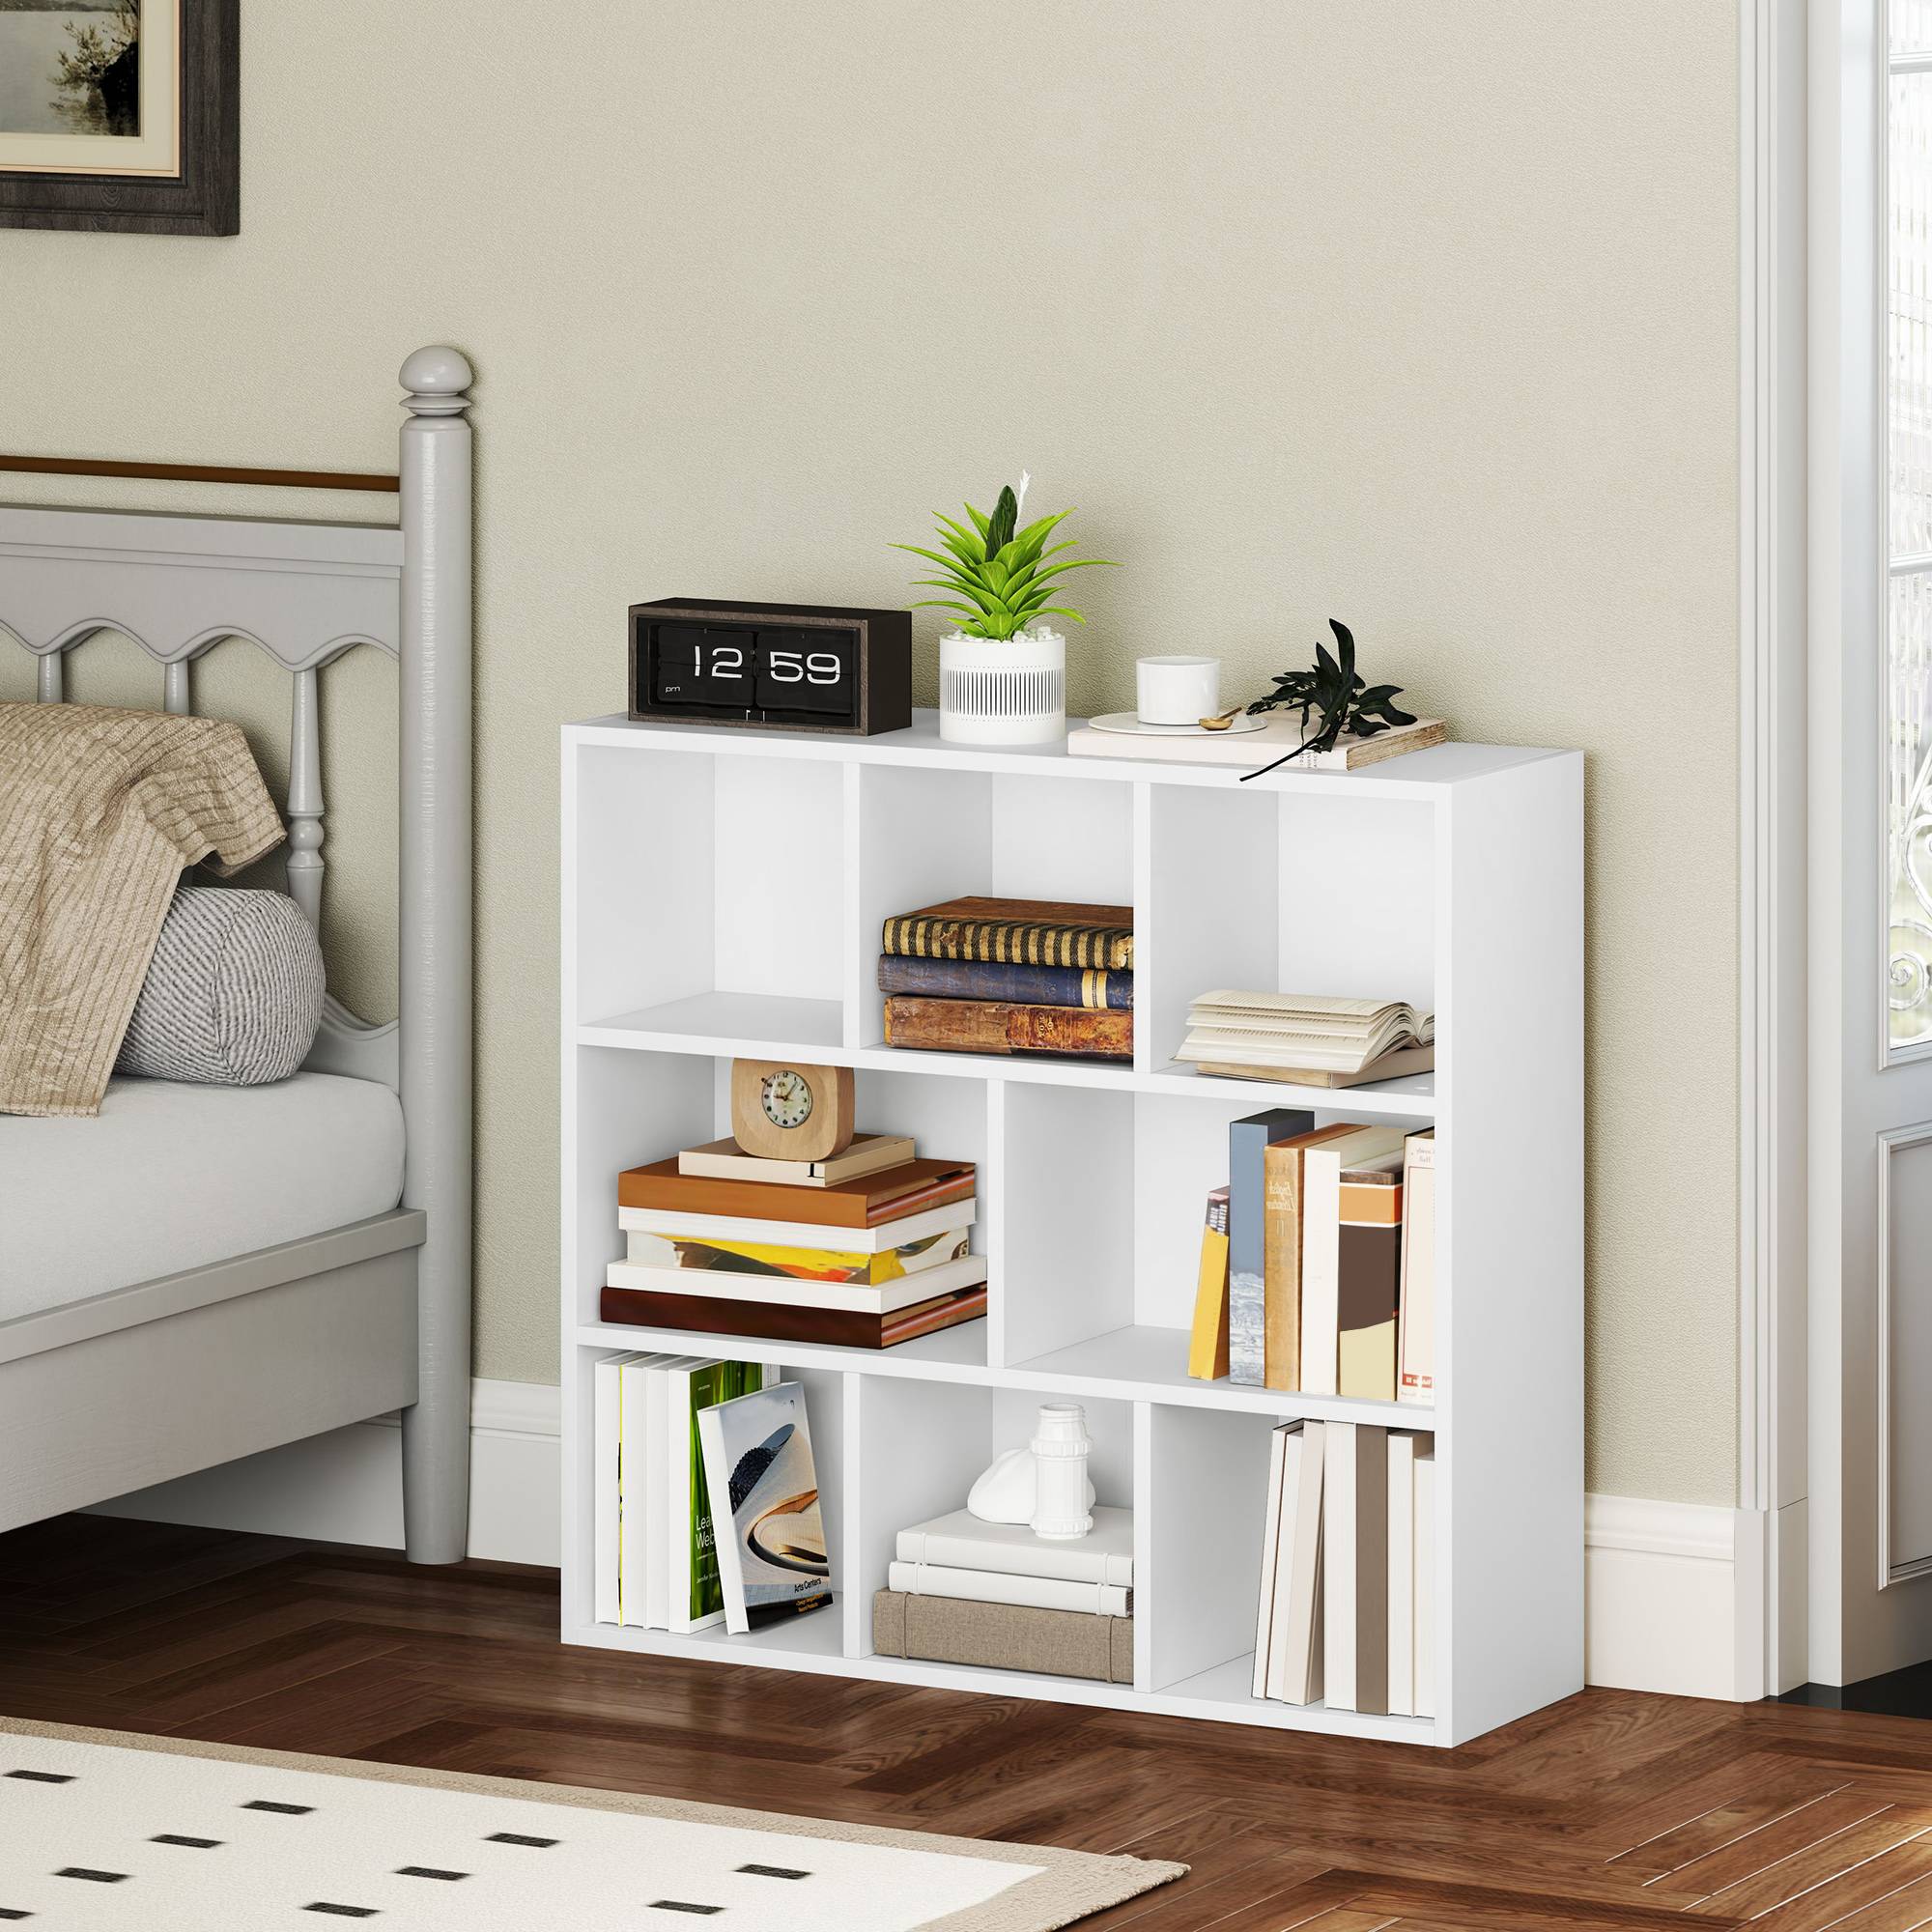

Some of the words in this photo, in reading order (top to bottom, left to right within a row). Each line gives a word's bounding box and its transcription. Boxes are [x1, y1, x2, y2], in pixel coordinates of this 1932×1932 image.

[694, 645, 743, 679] 12
[770, 651, 840, 685] 59
[665, 685, 681, 694] pm
[804, 1577, 822, 1590] Centers
